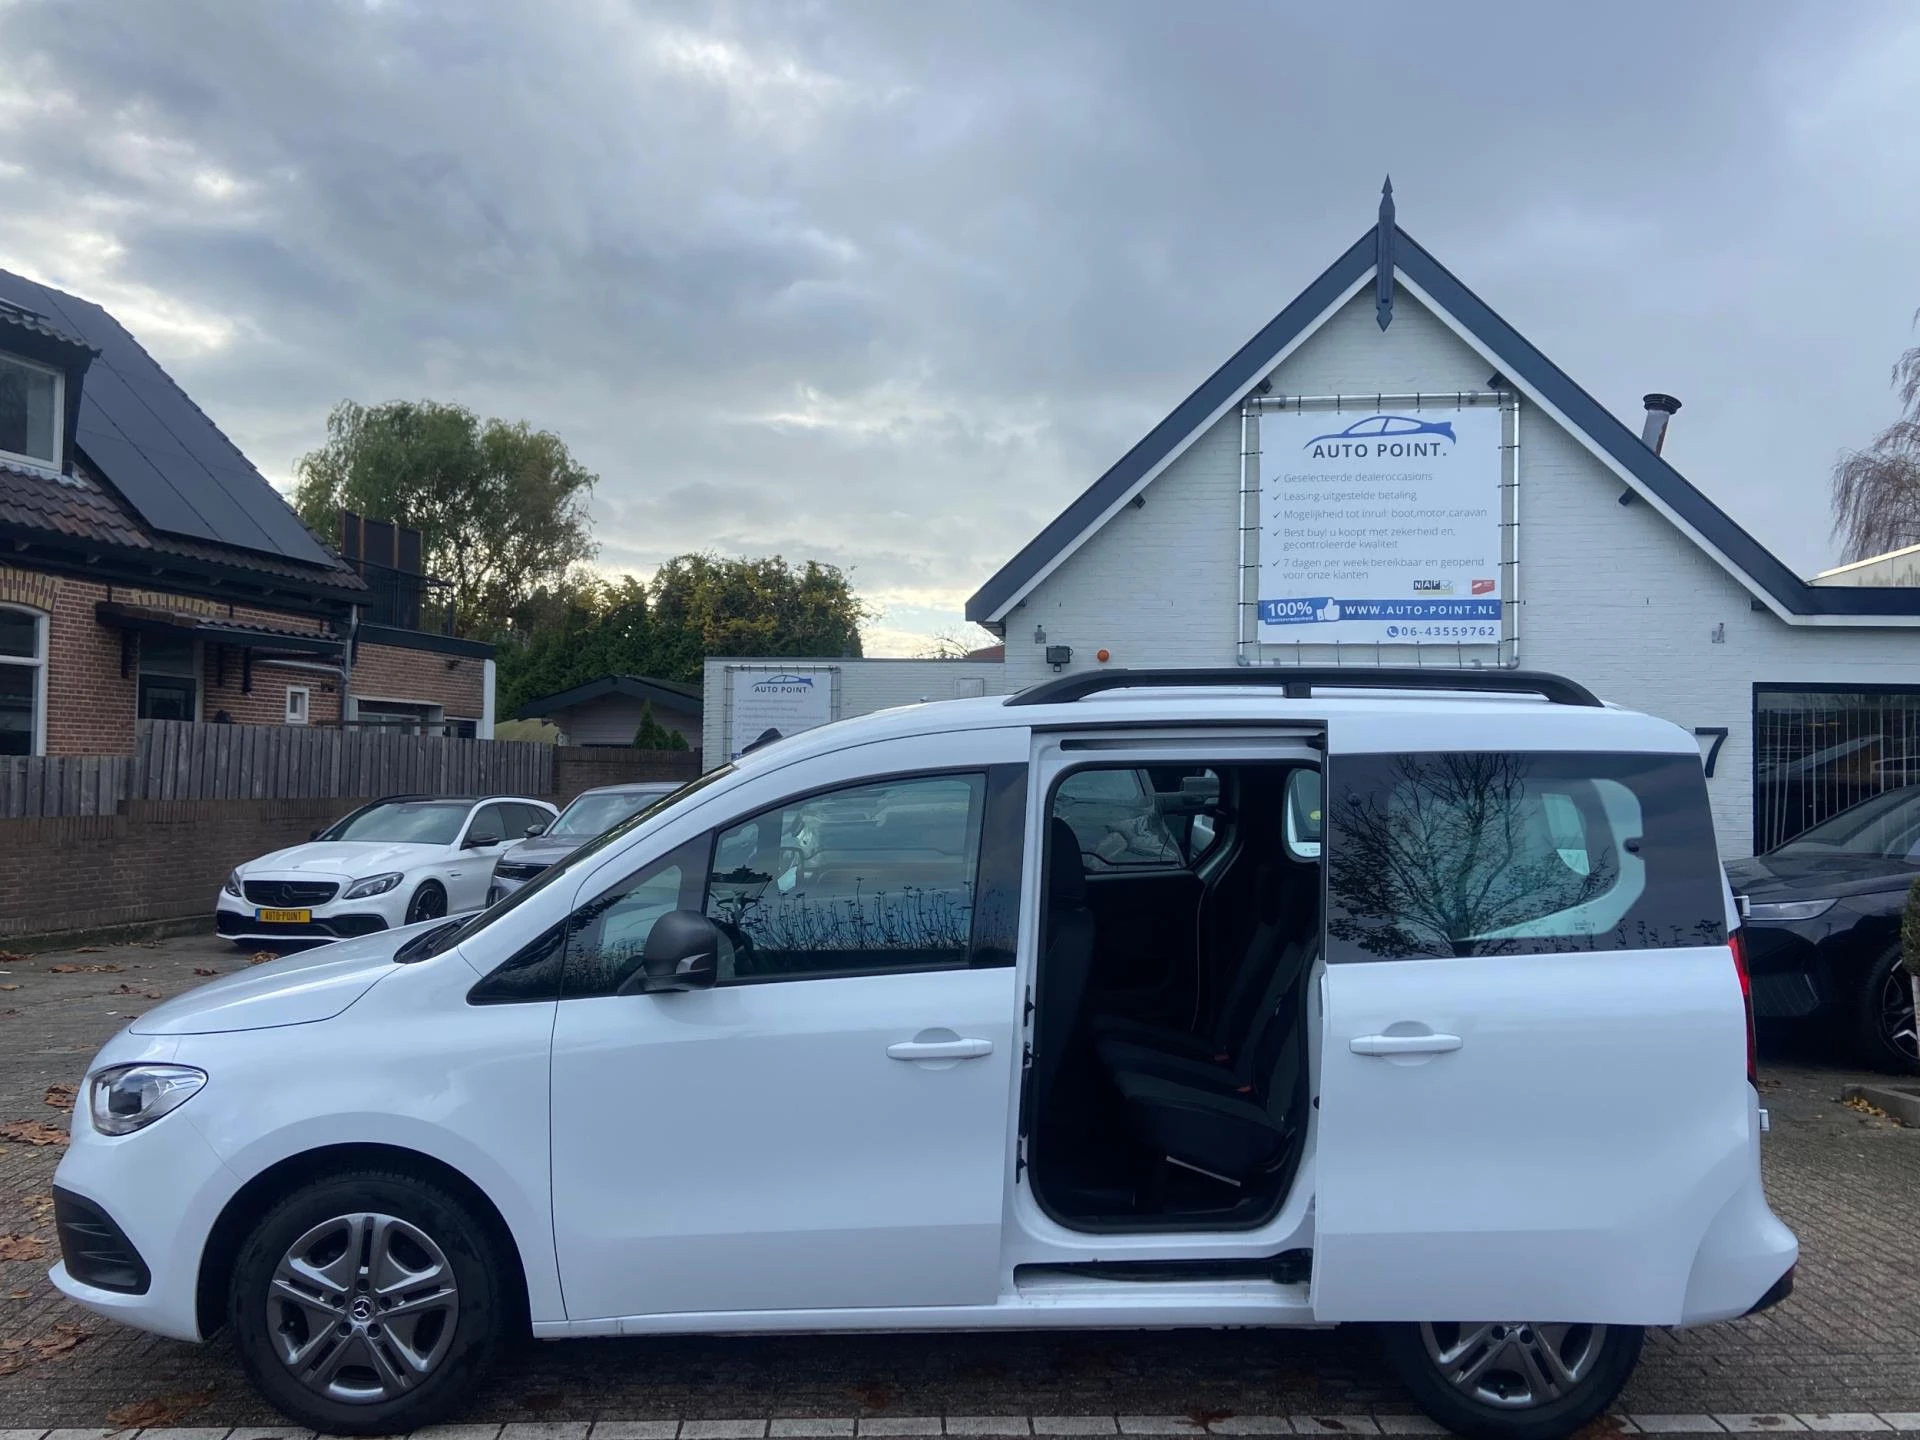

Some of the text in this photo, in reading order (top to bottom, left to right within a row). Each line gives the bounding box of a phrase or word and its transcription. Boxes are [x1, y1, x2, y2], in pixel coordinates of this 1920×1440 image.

[1313, 444, 1368, 458] AUTO
[1284, 473, 1433, 482] Geselecteerde dealeroccasions
[1378, 491, 1417, 502] betaling
[1284, 509, 1343, 521] Mogelijkheid
[1346, 510, 1360, 519] tot
[1362, 509, 1386, 518] inruil
[1284, 528, 1304, 537] Best
[1339, 527, 1366, 539] koopt
[1369, 528, 1388, 536] met
[1391, 527, 1438, 536] zekerheid
[1283, 539, 1397, 551] gecontroleerde kwaliteit
[1284, 559, 1289, 567] 7
[1292, 558, 1321, 569] dagen
[1325, 559, 1340, 569] per
[1343, 558, 1368, 566] week
[1440, 557, 1484, 568] geopend
[1307, 571, 1330, 579] onze
[1333, 570, 1368, 579] klanten
[1414, 580, 1440, 590] NAP
[1267, 602, 1313, 616] 100%
[1345, 606, 1495, 615] WWW.AUTO-POINT.NL
[1401, 627, 1495, 636] 06-43559762
[1695, 727, 1728, 778] 7
[265, 912, 301, 920] AUTO-POINT
